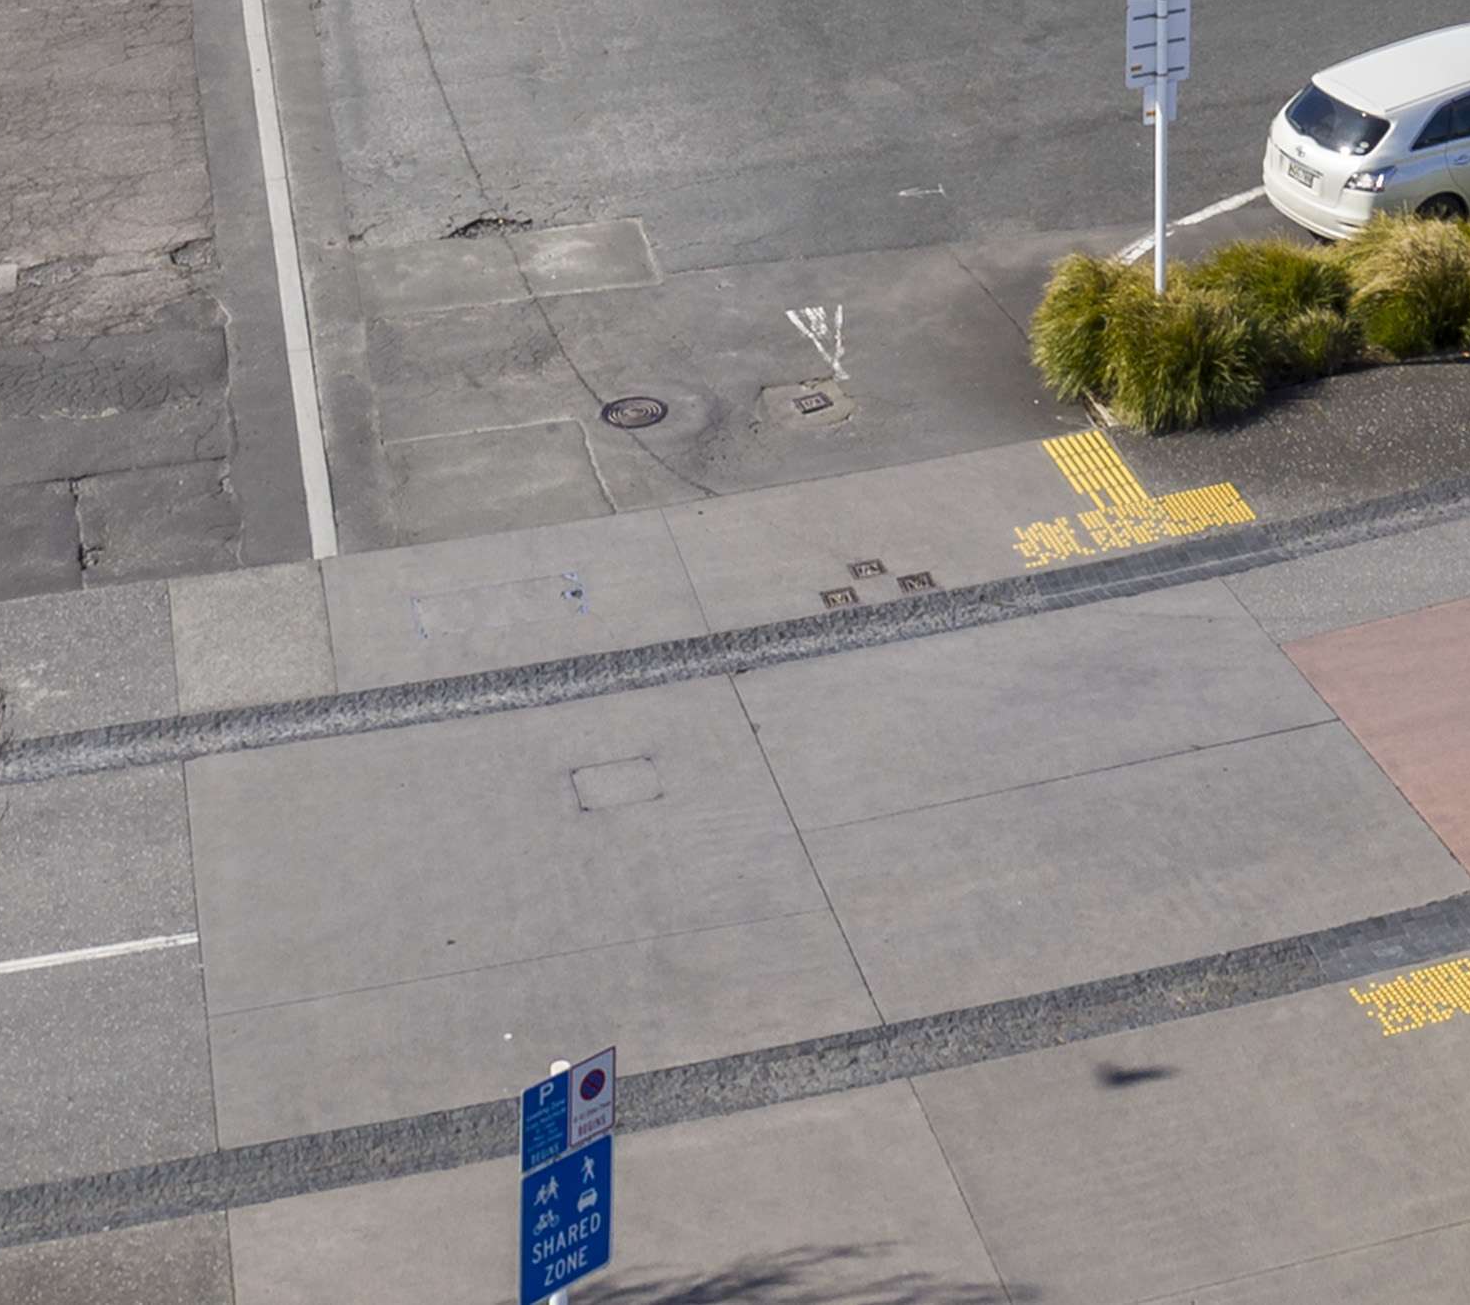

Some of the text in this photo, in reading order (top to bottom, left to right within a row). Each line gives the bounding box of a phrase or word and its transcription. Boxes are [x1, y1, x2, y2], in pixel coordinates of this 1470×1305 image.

[539, 1081, 555, 1106] P
[532, 1212, 601, 1264] SHARED
[544, 1244, 589, 1287] ZONE
